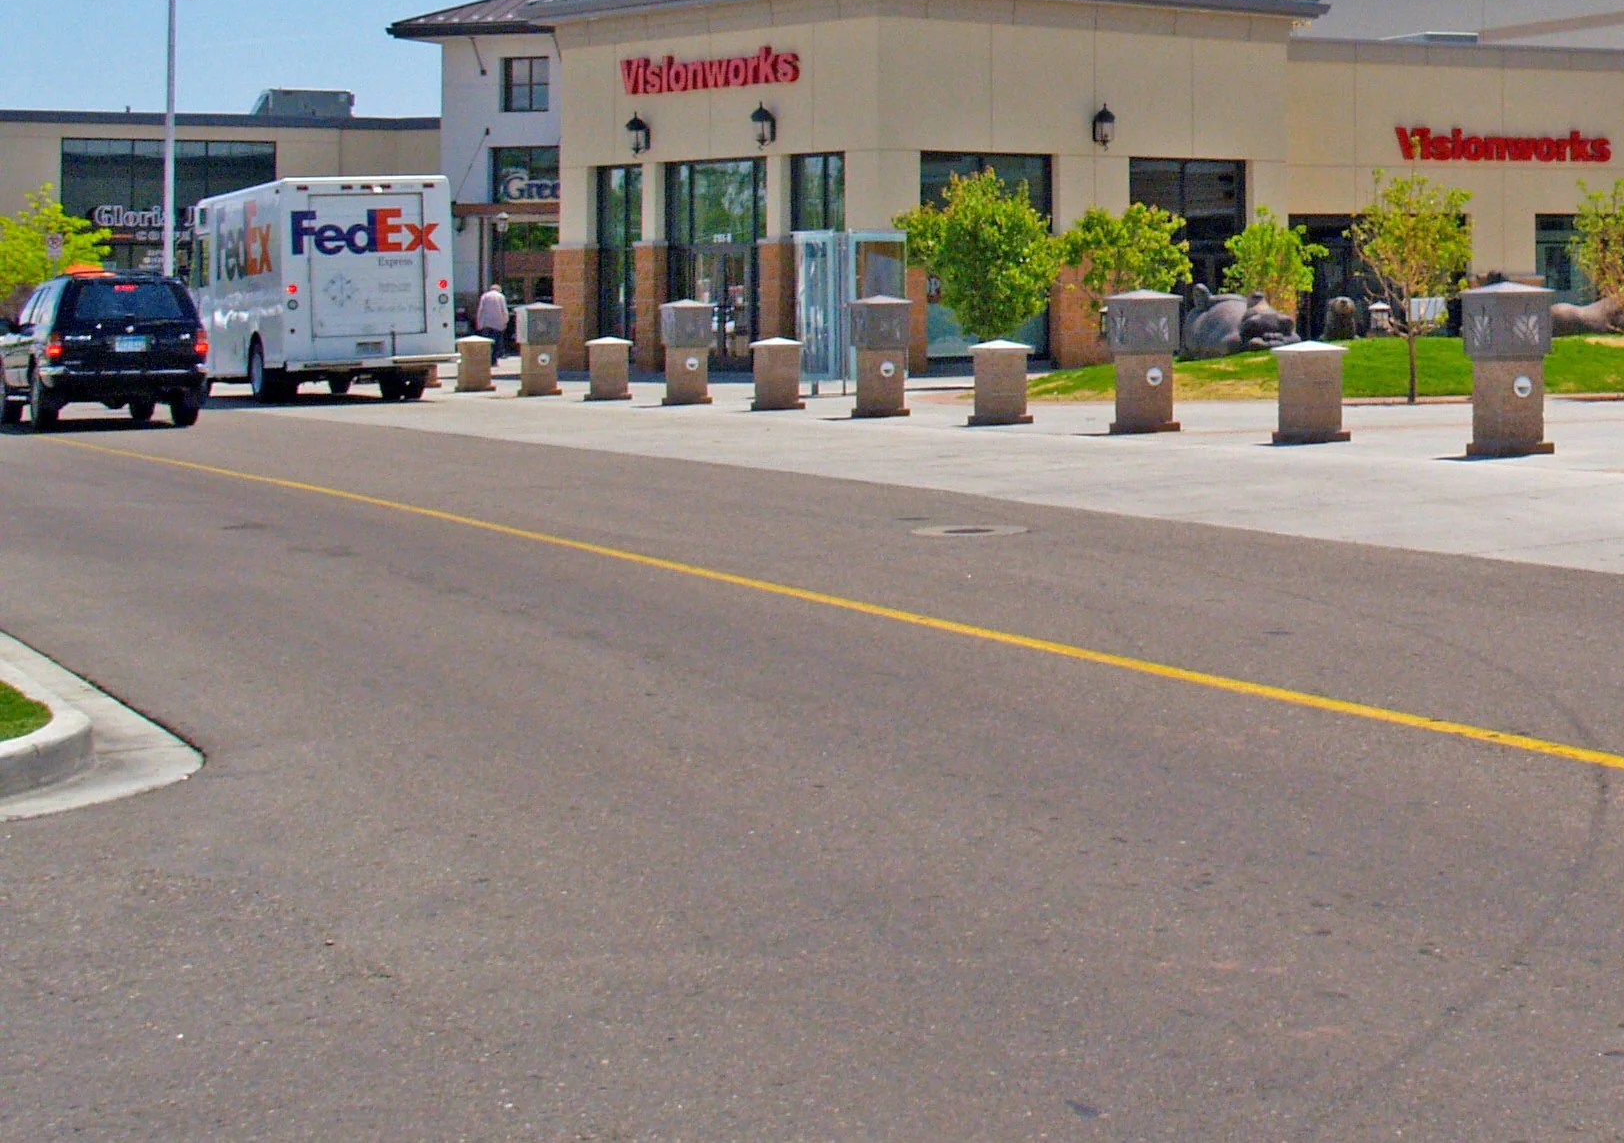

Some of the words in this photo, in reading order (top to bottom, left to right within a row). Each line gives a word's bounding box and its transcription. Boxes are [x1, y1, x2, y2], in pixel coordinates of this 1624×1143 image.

[620, 45, 800, 95] Visionworks
[1394, 126, 1613, 163] Visionworks
[94, 205, 165, 227] Glori
[290, 207, 440, 256] FedEx
[216, 199, 274, 282] FedEx
[378, 256, 413, 268] Express
